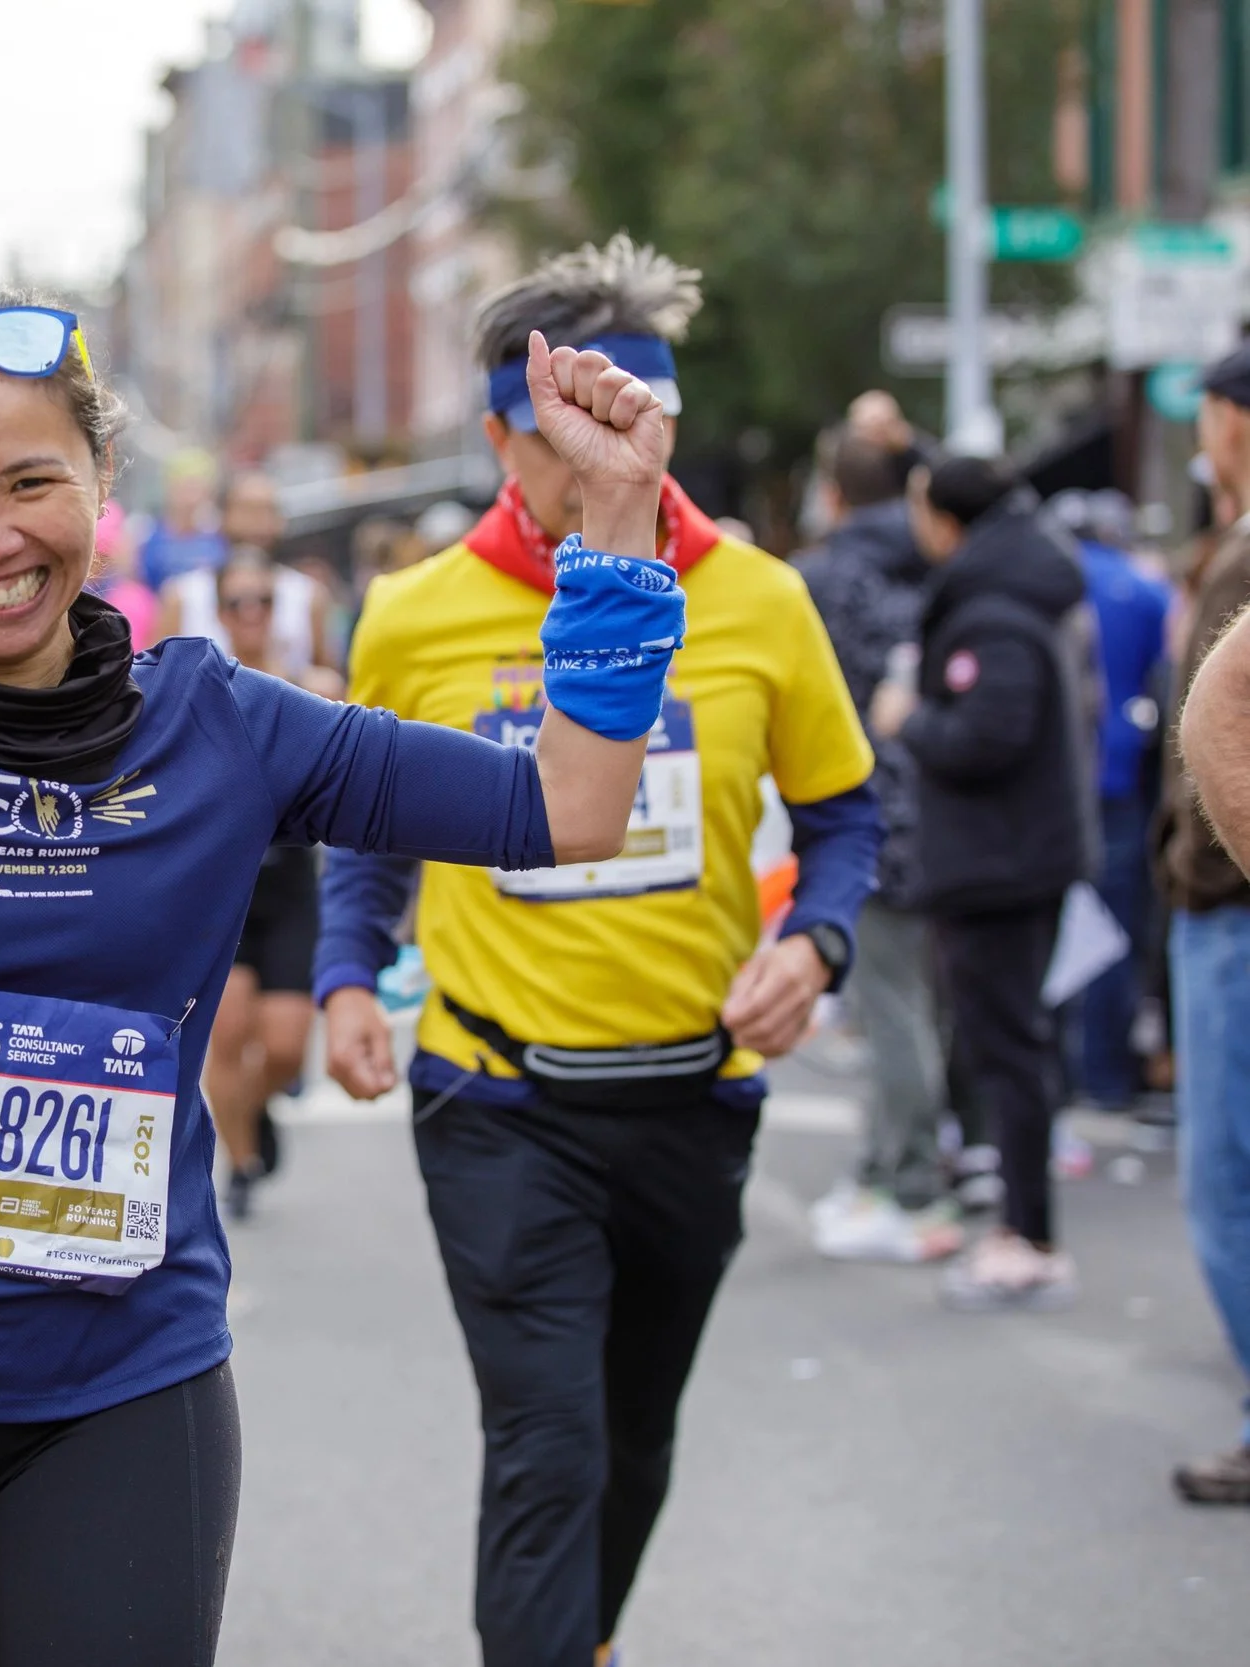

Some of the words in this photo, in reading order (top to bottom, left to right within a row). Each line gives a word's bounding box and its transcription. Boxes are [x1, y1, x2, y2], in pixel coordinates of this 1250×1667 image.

[41, 780, 70, 794] TCS
[68, 791, 83, 813] NEW
[73, 814, 83, 839] YORK
[38, 847, 100, 858] RUNNING
[65, 889, 93, 897] RUNNERS
[11, 1023, 44, 1038] TATA
[8, 1036, 85, 1056] CONSULTANCY
[7, 1049, 56, 1066] SERVICES
[103, 1057, 144, 1077] TATA
[134, 1114, 155, 1177] 2021
[68, 1204, 82, 1213] 50
[84, 1205, 118, 1218] YEARS
[66, 1213, 117, 1228] RUNNING
[46, 1250, 146, 1269] #TCSNYCMarathon
[15, 1267, 34, 1276] CALL
